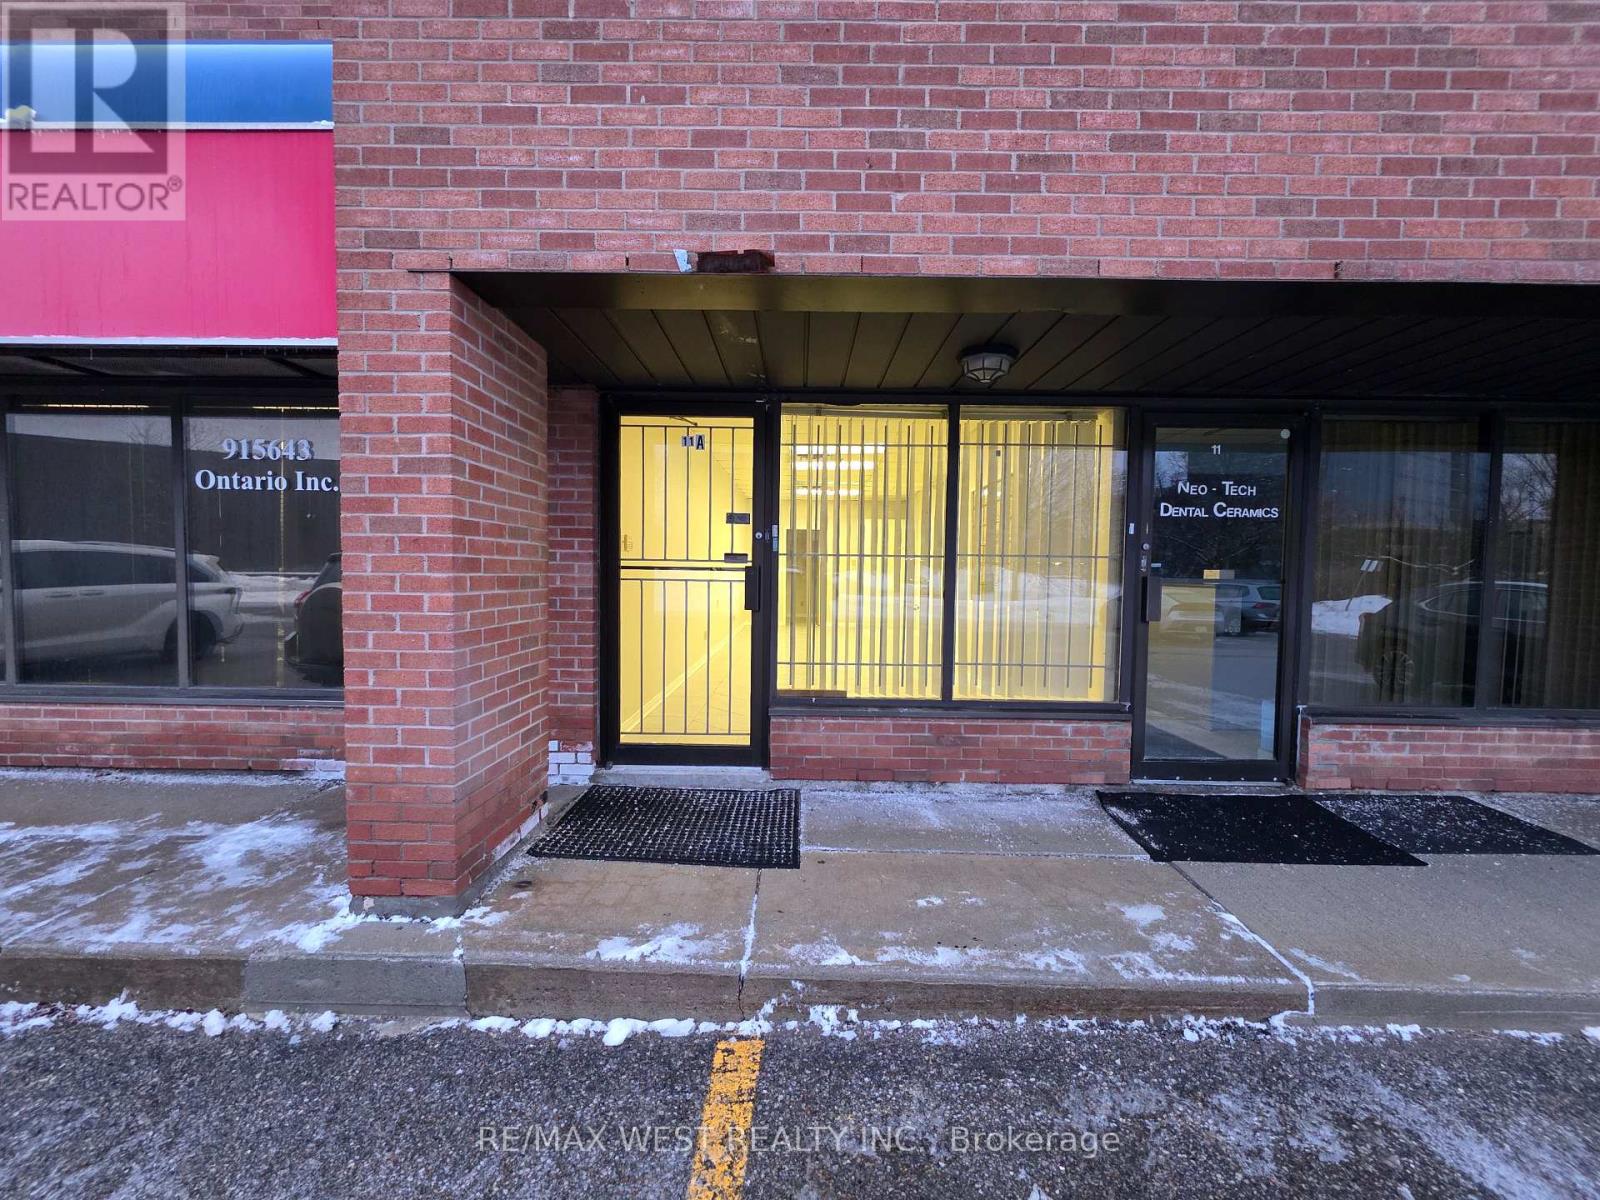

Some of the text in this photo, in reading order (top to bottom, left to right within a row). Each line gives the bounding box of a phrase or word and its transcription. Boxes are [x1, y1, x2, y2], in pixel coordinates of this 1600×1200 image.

[221, 438, 314, 461] 915643
[1211, 444, 1221, 455] 11
[195, 469, 339, 492] Ontario Inc.
[1177, 481, 1208, 496] NEO
[1221, 481, 1257, 497] TECH
[1160, 502, 1279, 519] DENTAL CERAMICS
